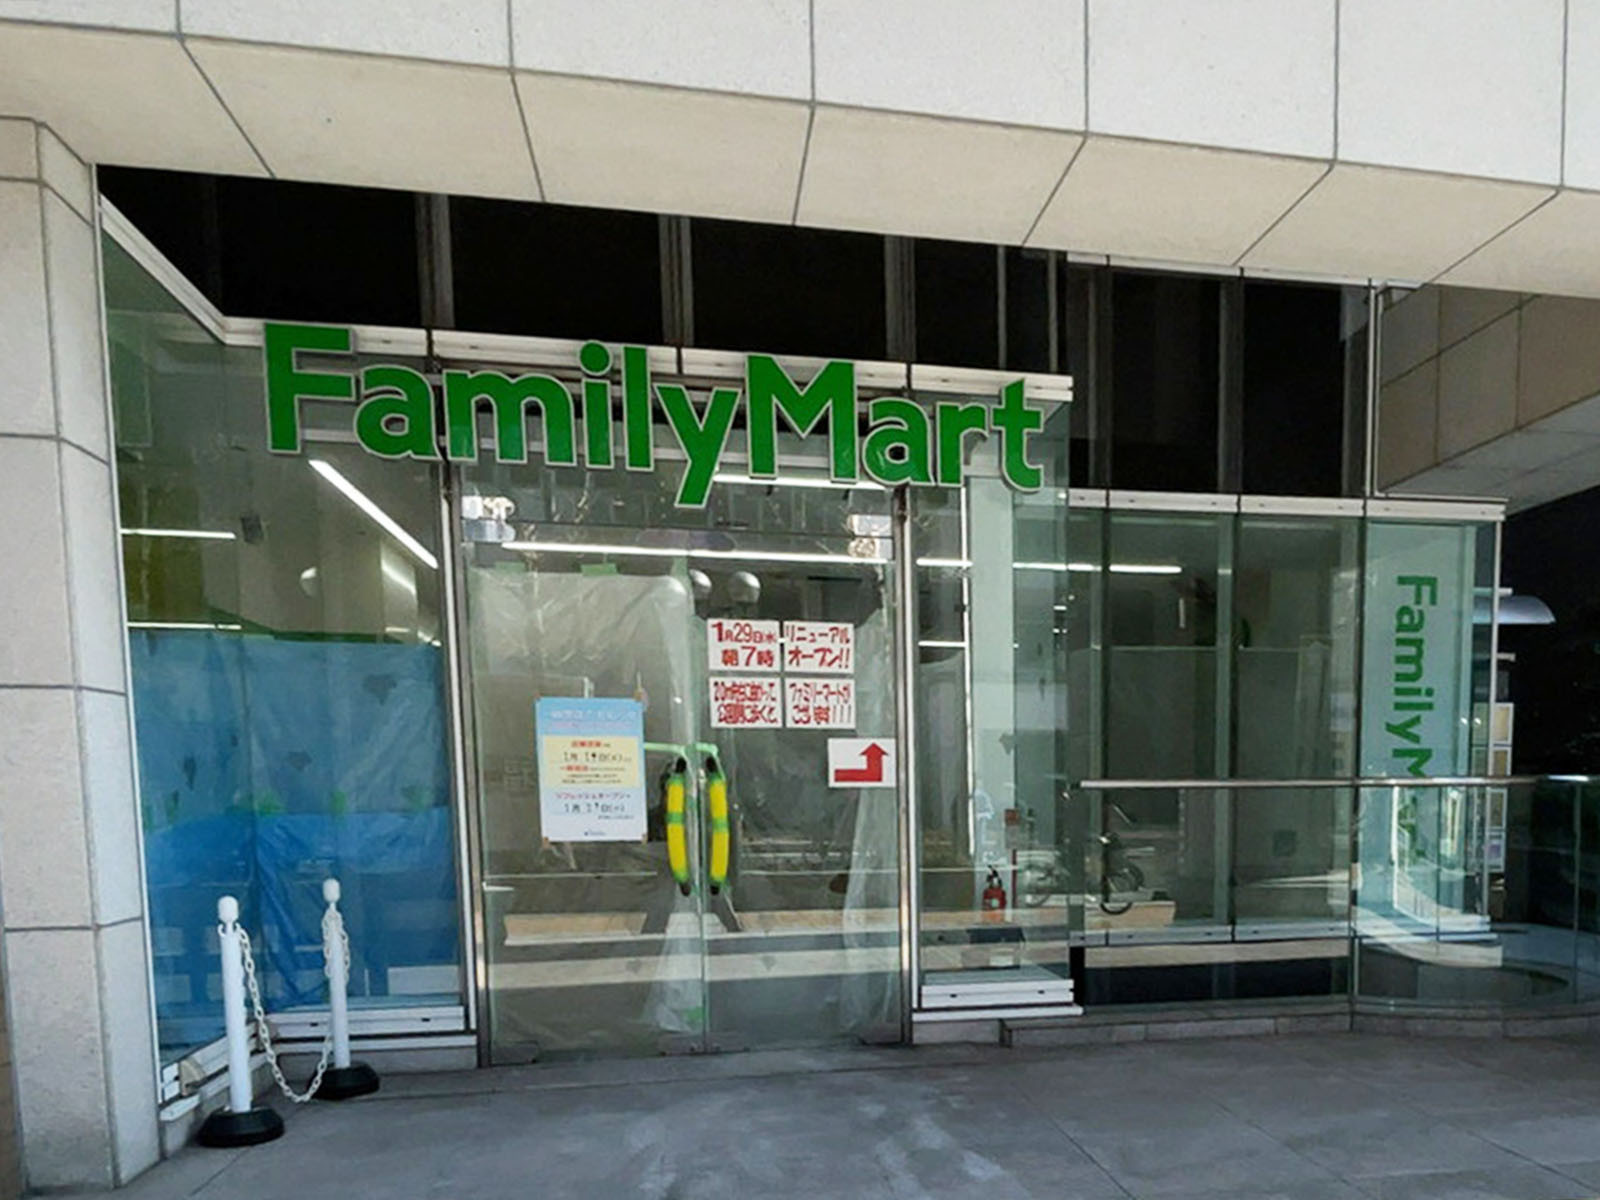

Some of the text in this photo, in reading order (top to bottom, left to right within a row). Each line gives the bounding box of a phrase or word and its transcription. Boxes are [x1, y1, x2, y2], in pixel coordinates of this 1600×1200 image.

[263, 321, 1046, 509] FamilyMart
[785, 624, 851, 645] リニューアル
